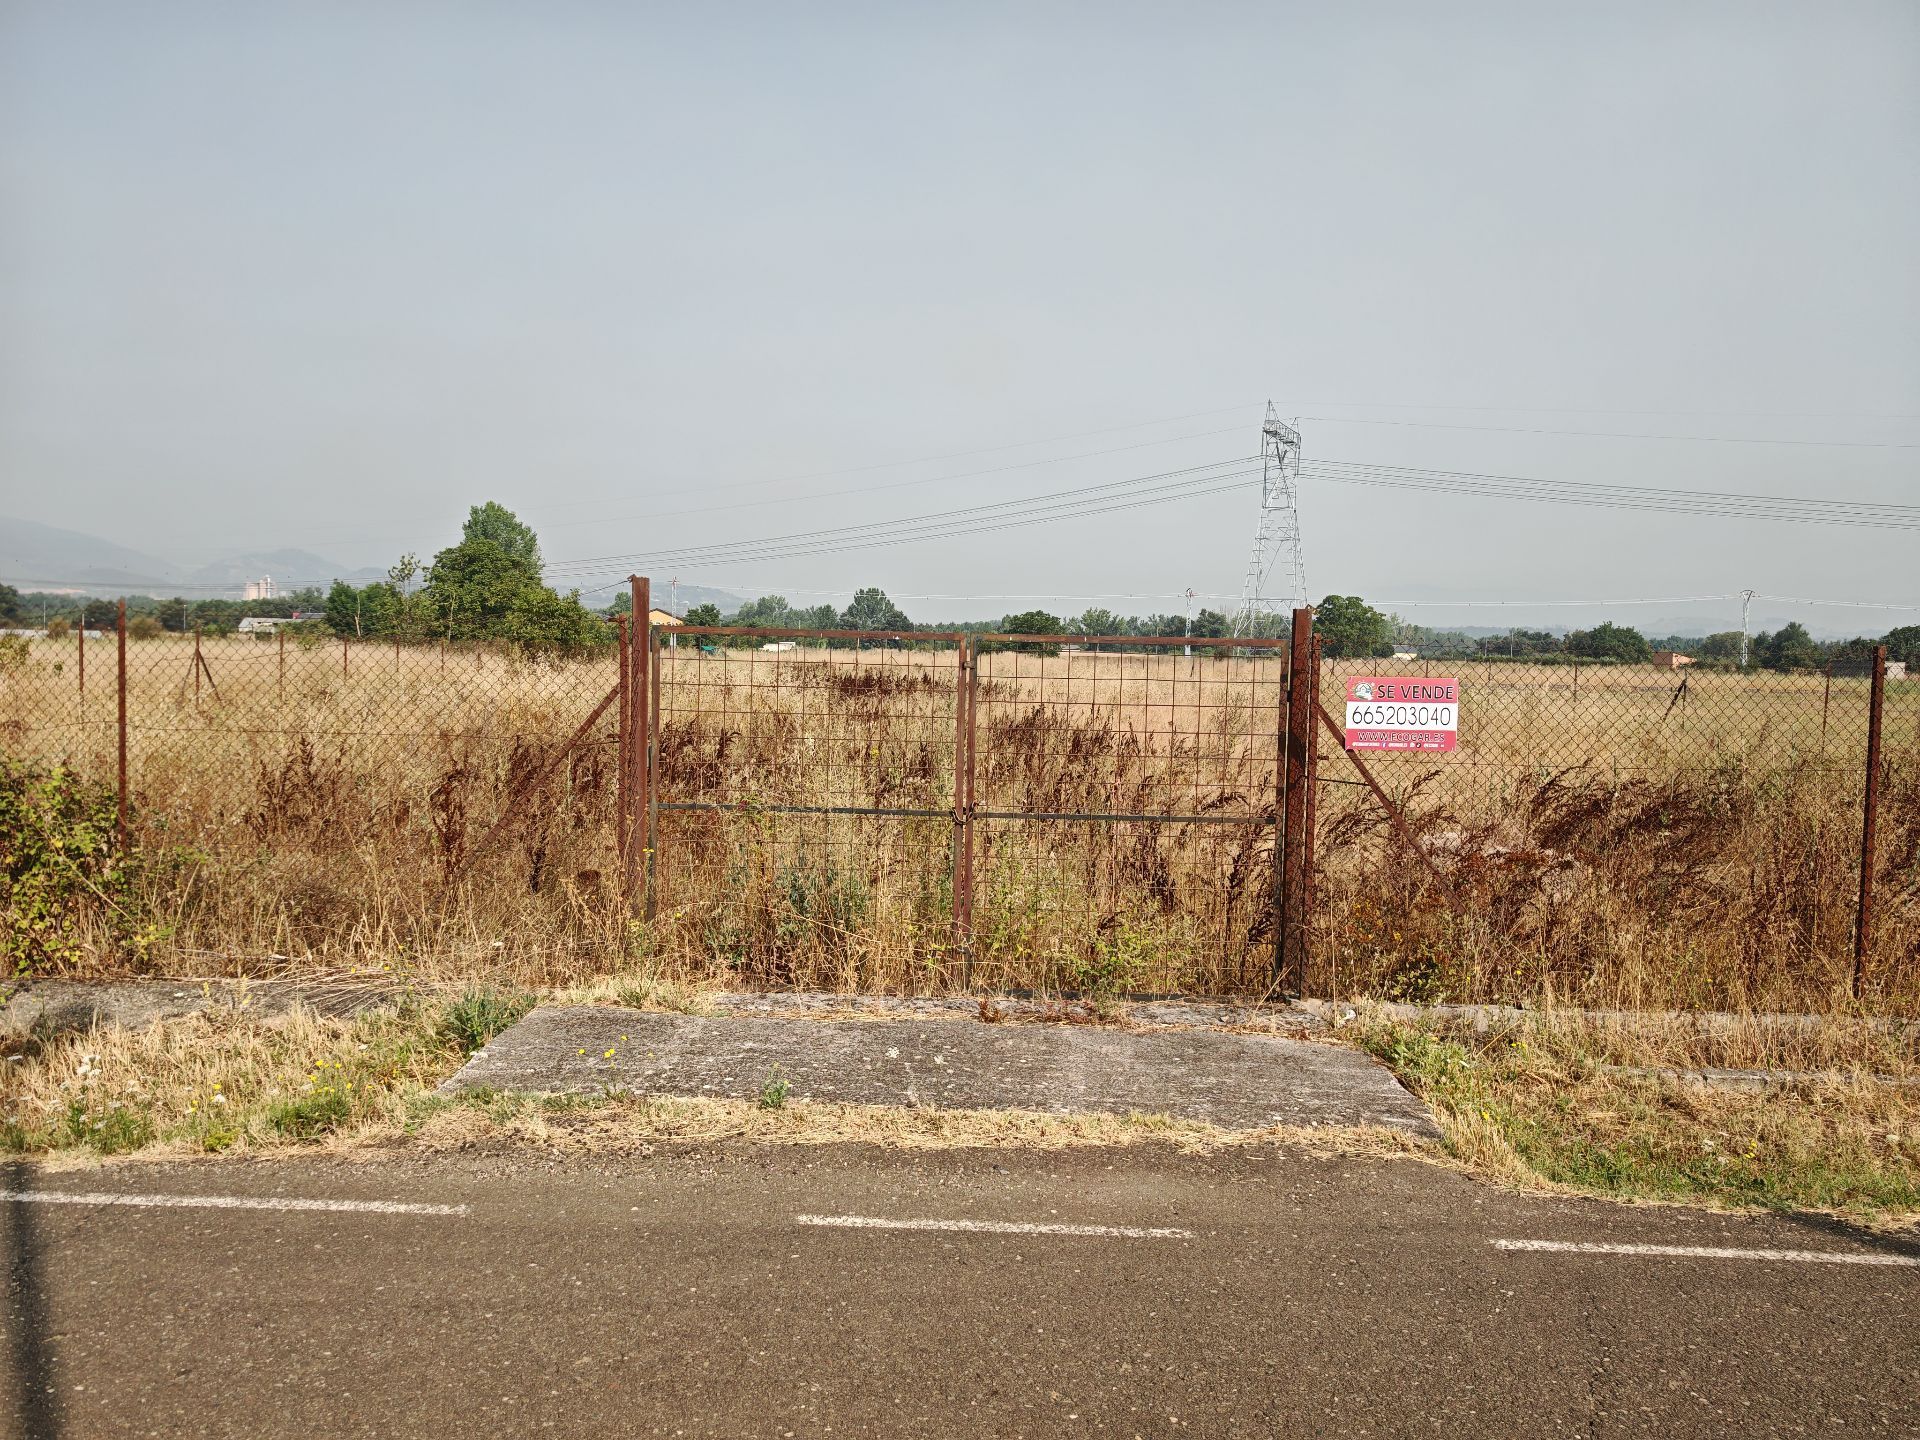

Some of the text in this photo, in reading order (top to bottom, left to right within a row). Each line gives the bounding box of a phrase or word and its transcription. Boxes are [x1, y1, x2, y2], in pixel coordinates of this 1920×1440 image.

[1377, 685, 1454, 700] SE VENDE
[1352, 705, 1451, 726] 665203040
[1357, 732, 1445, 742] WWW.ECOGAR.ES
